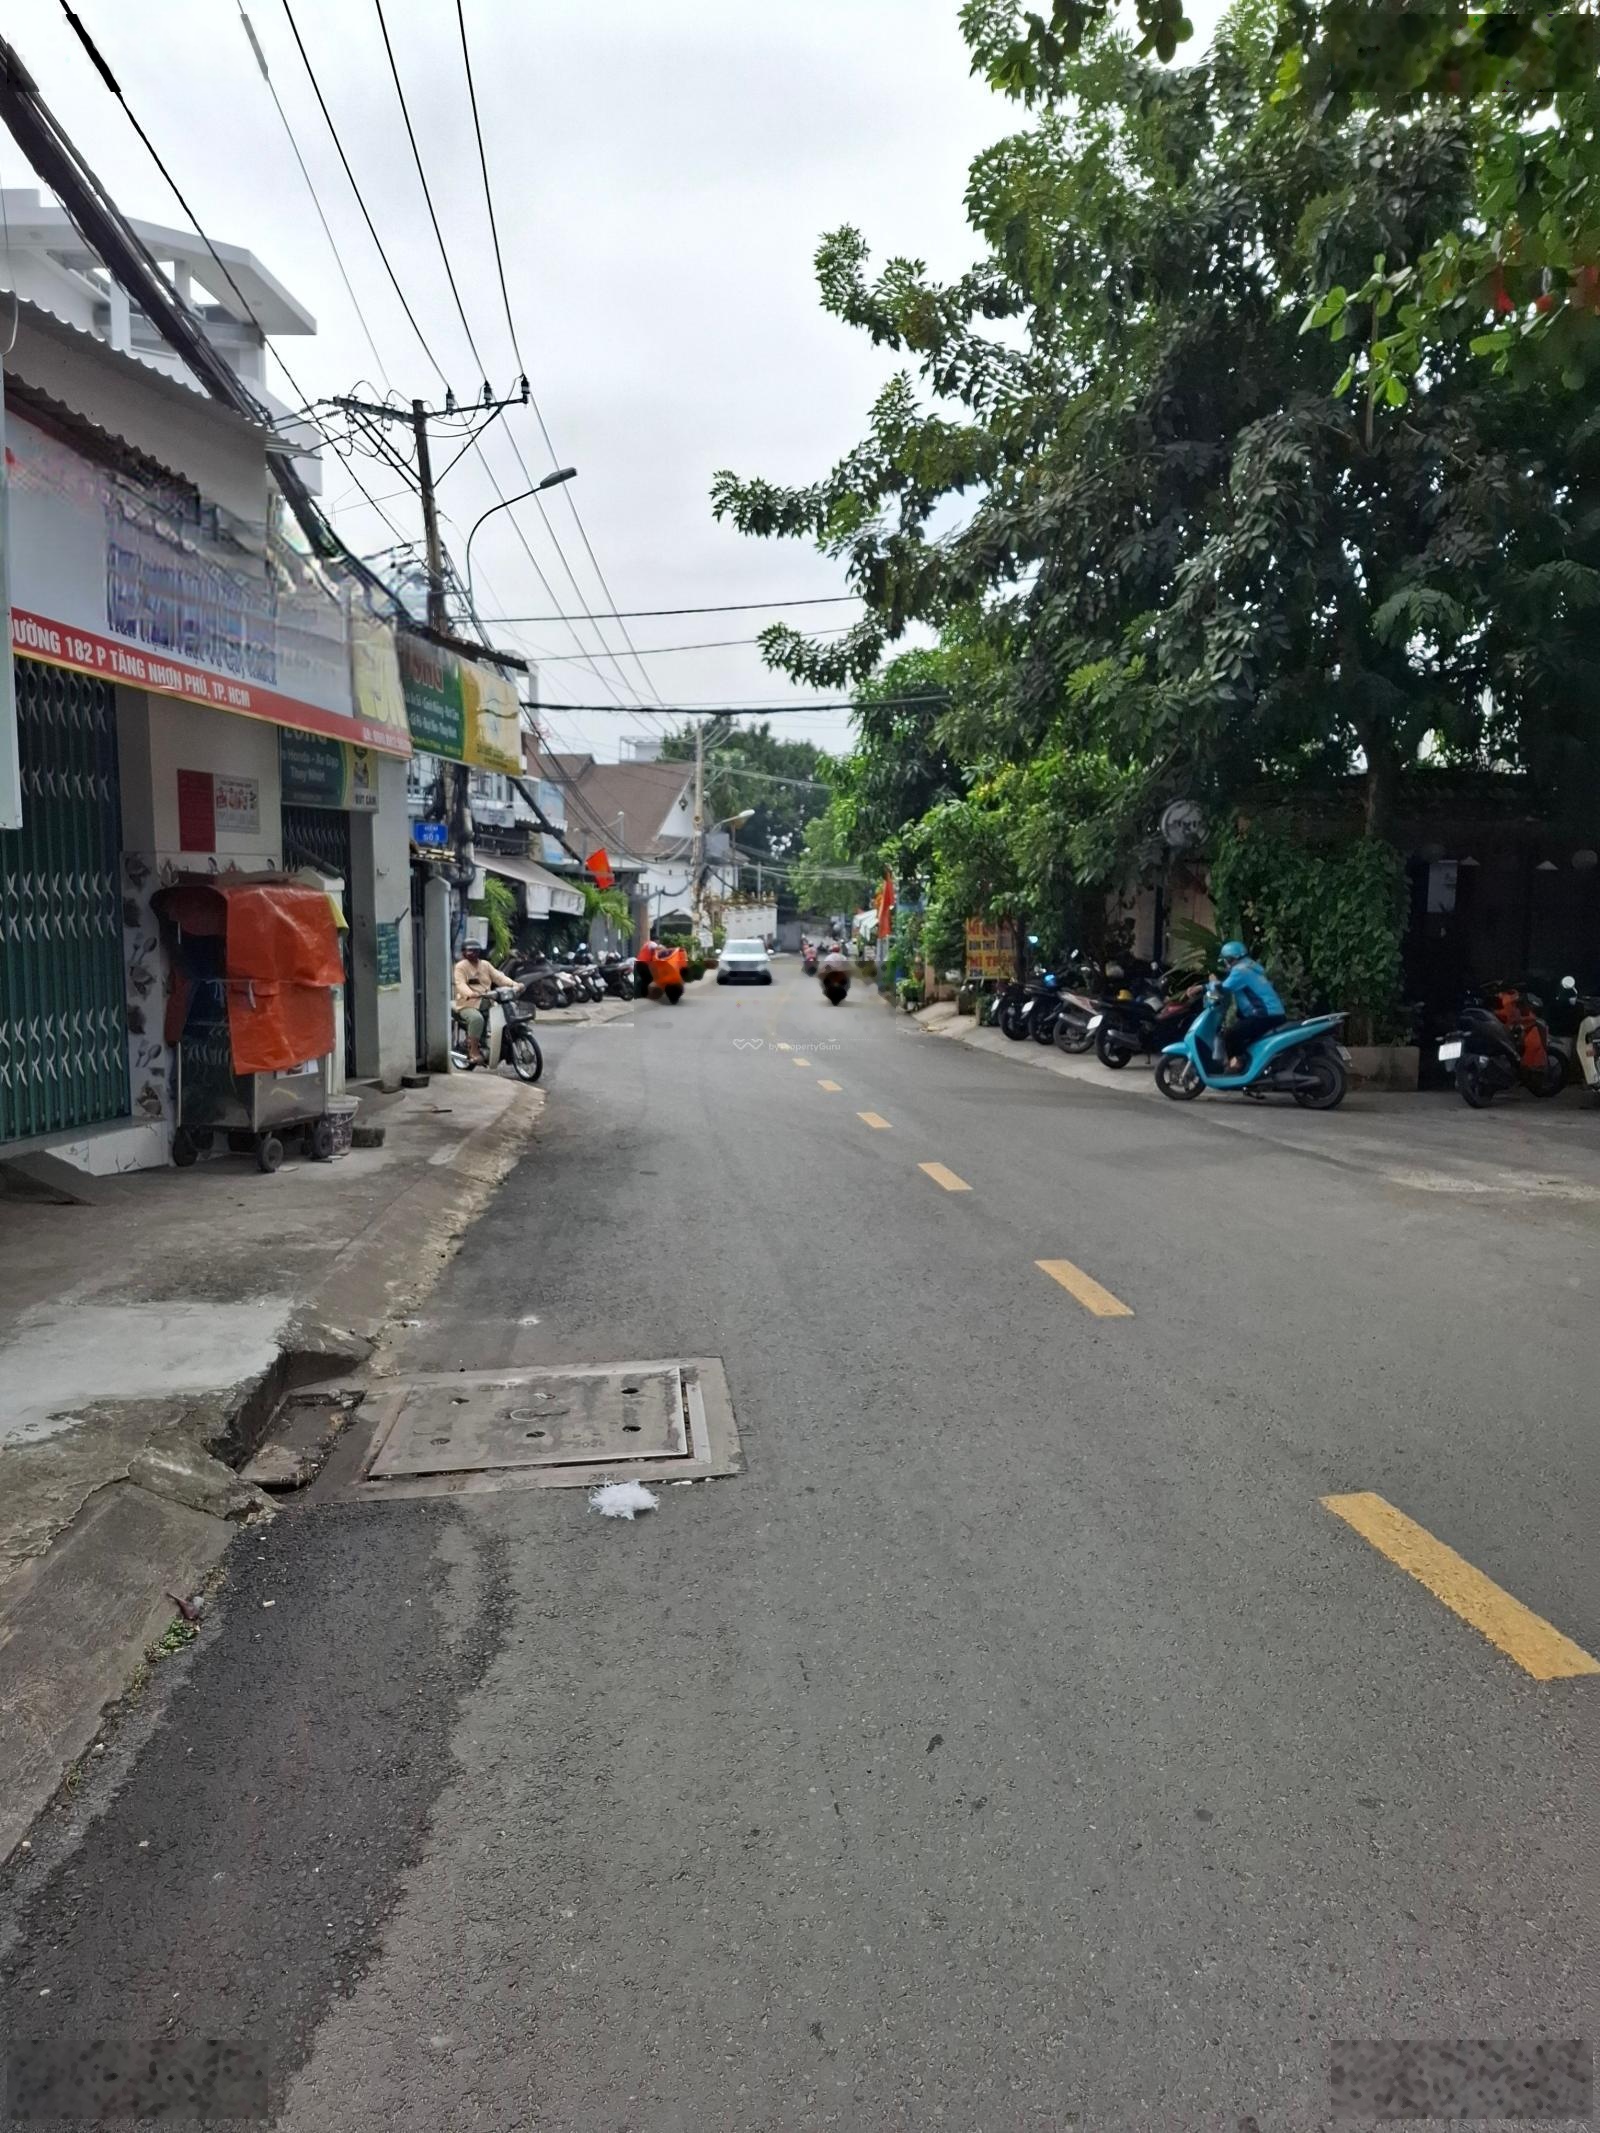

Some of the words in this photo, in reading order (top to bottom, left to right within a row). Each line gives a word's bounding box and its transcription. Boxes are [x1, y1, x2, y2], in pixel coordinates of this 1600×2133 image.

[65, 637, 94, 664] 182
[96, 645, 107, 666] P
[109, 649, 146, 679] TĂNG
[148, 661, 182, 690] NHƠN
[212, 681, 228, 702] TP.
[228, 686, 251, 708] HCM
